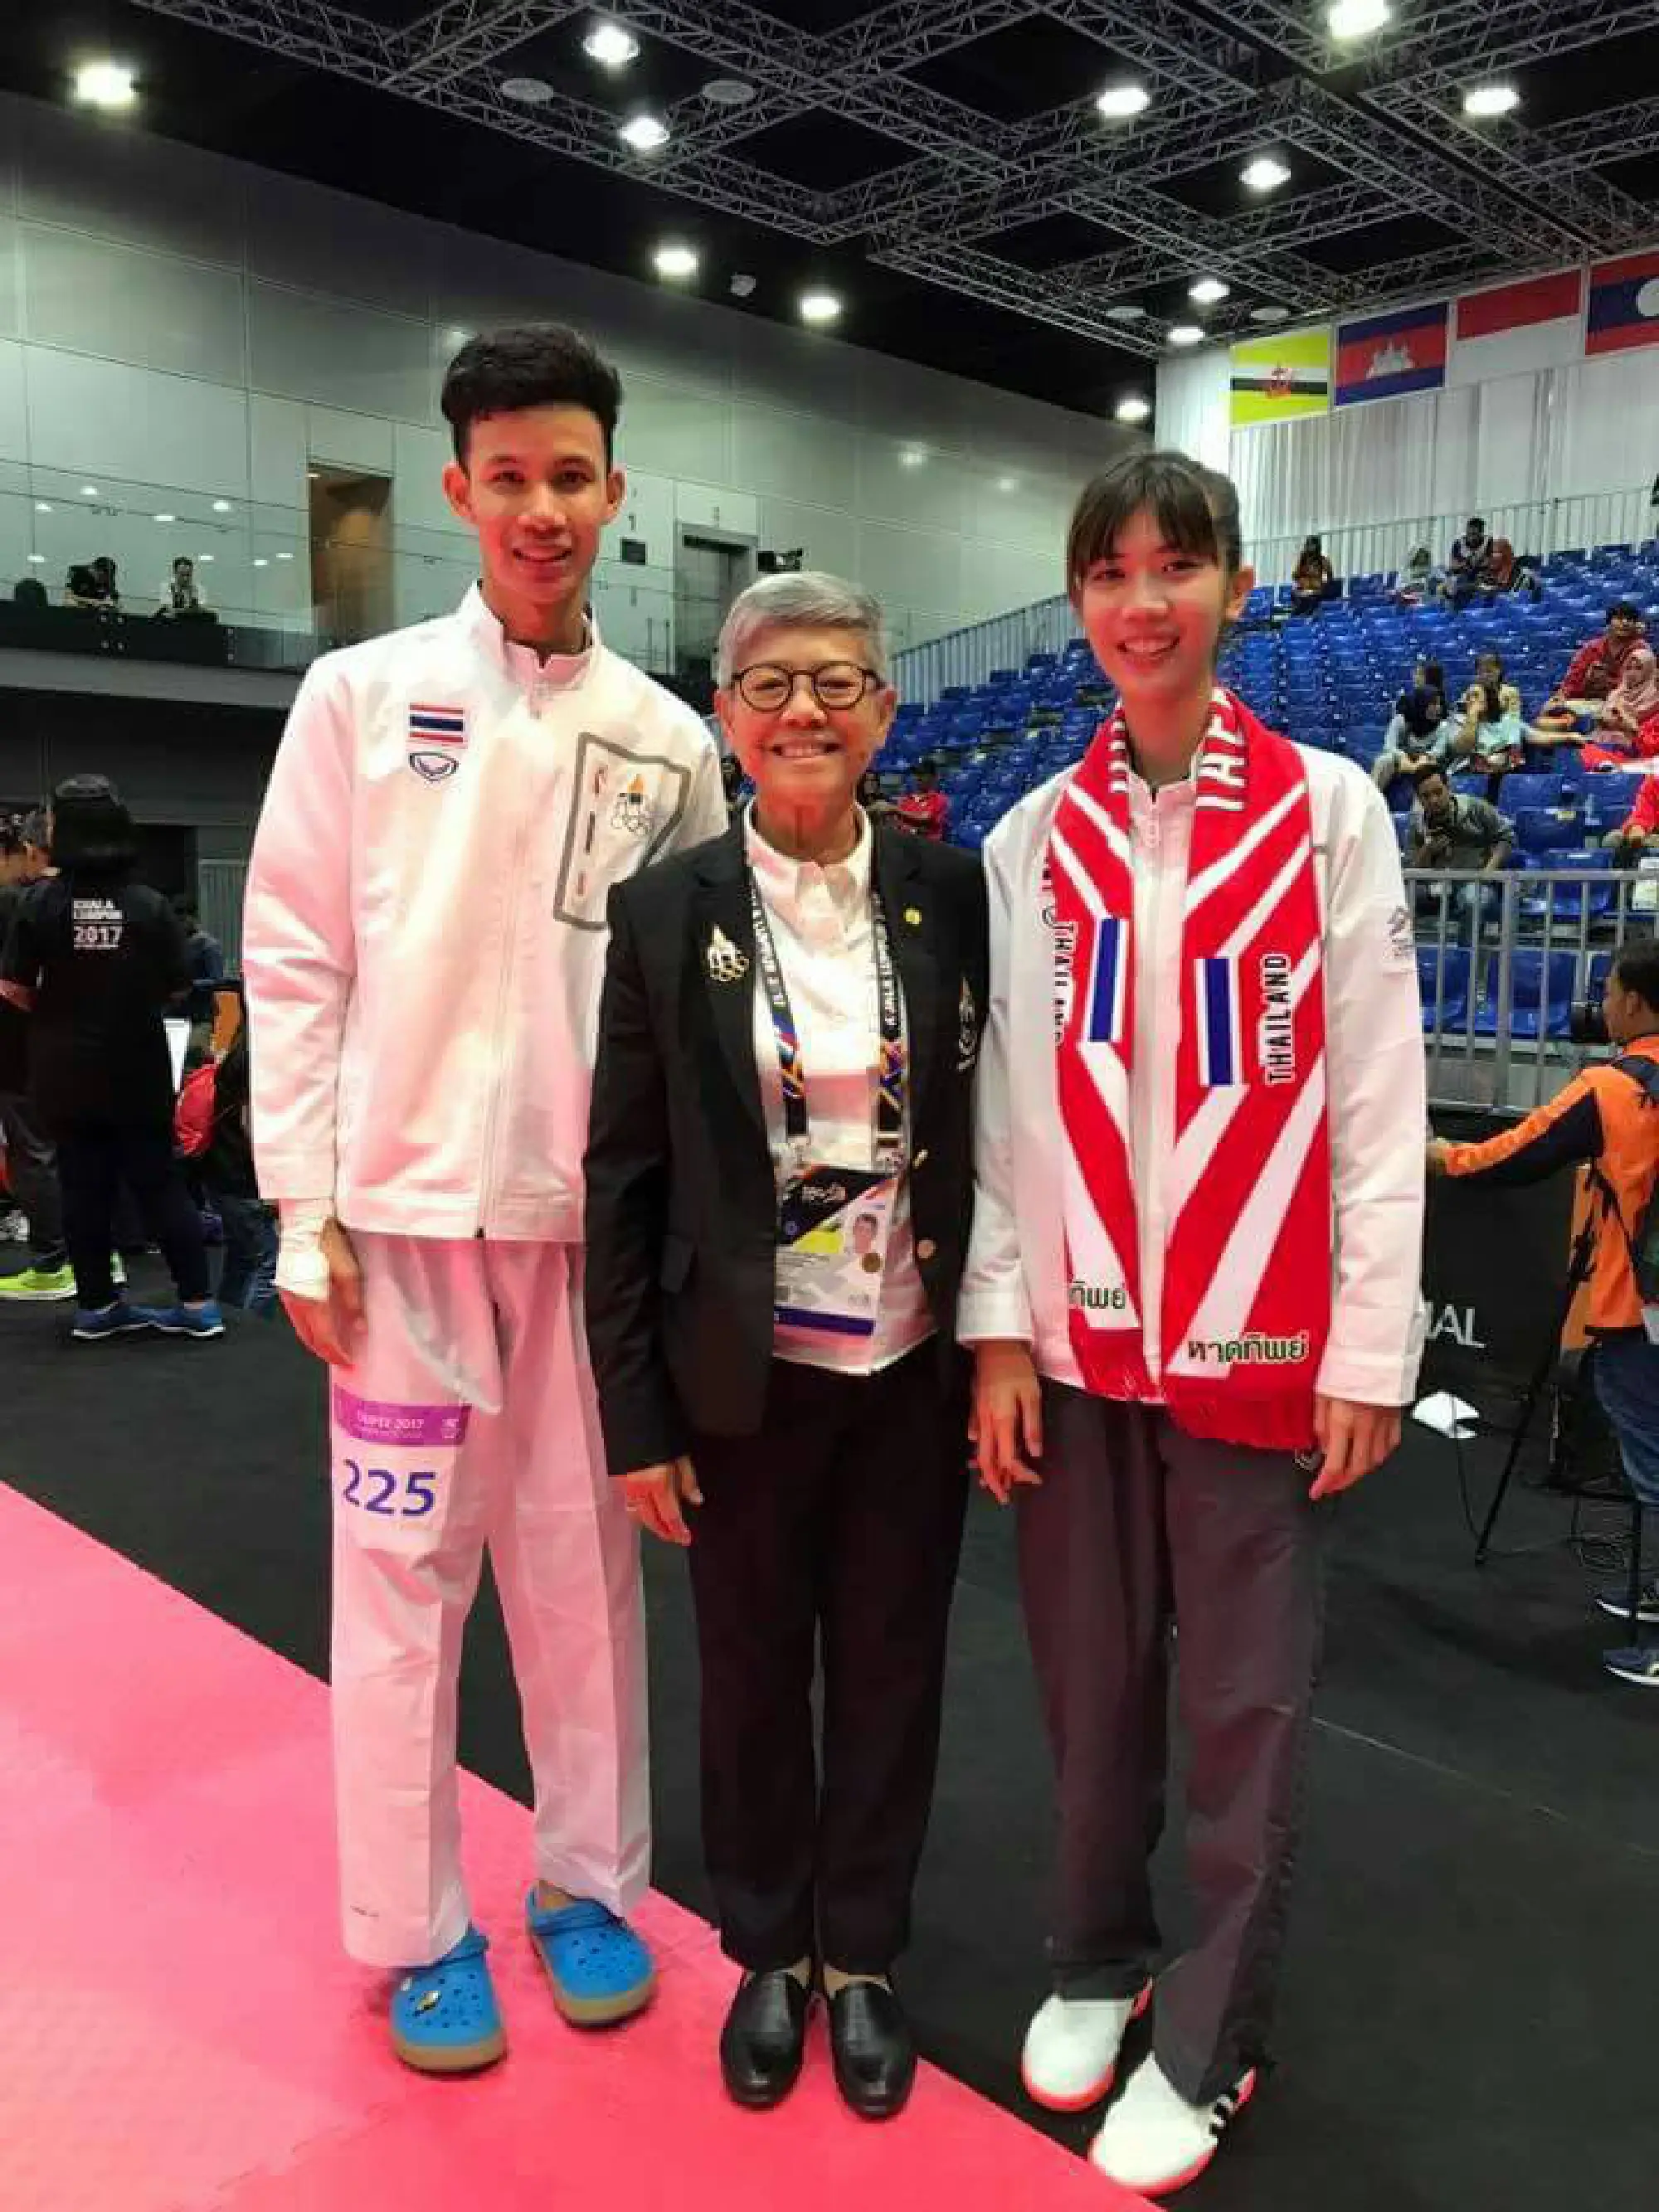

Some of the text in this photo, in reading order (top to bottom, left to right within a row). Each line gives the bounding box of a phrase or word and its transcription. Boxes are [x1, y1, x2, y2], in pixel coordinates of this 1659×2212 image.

[74, 926, 123, 944] 2017
[1263, 955, 1292, 1084] THAILAND
[396, 1418, 424, 1428] 2017
[343, 1458, 436, 1516] 225
